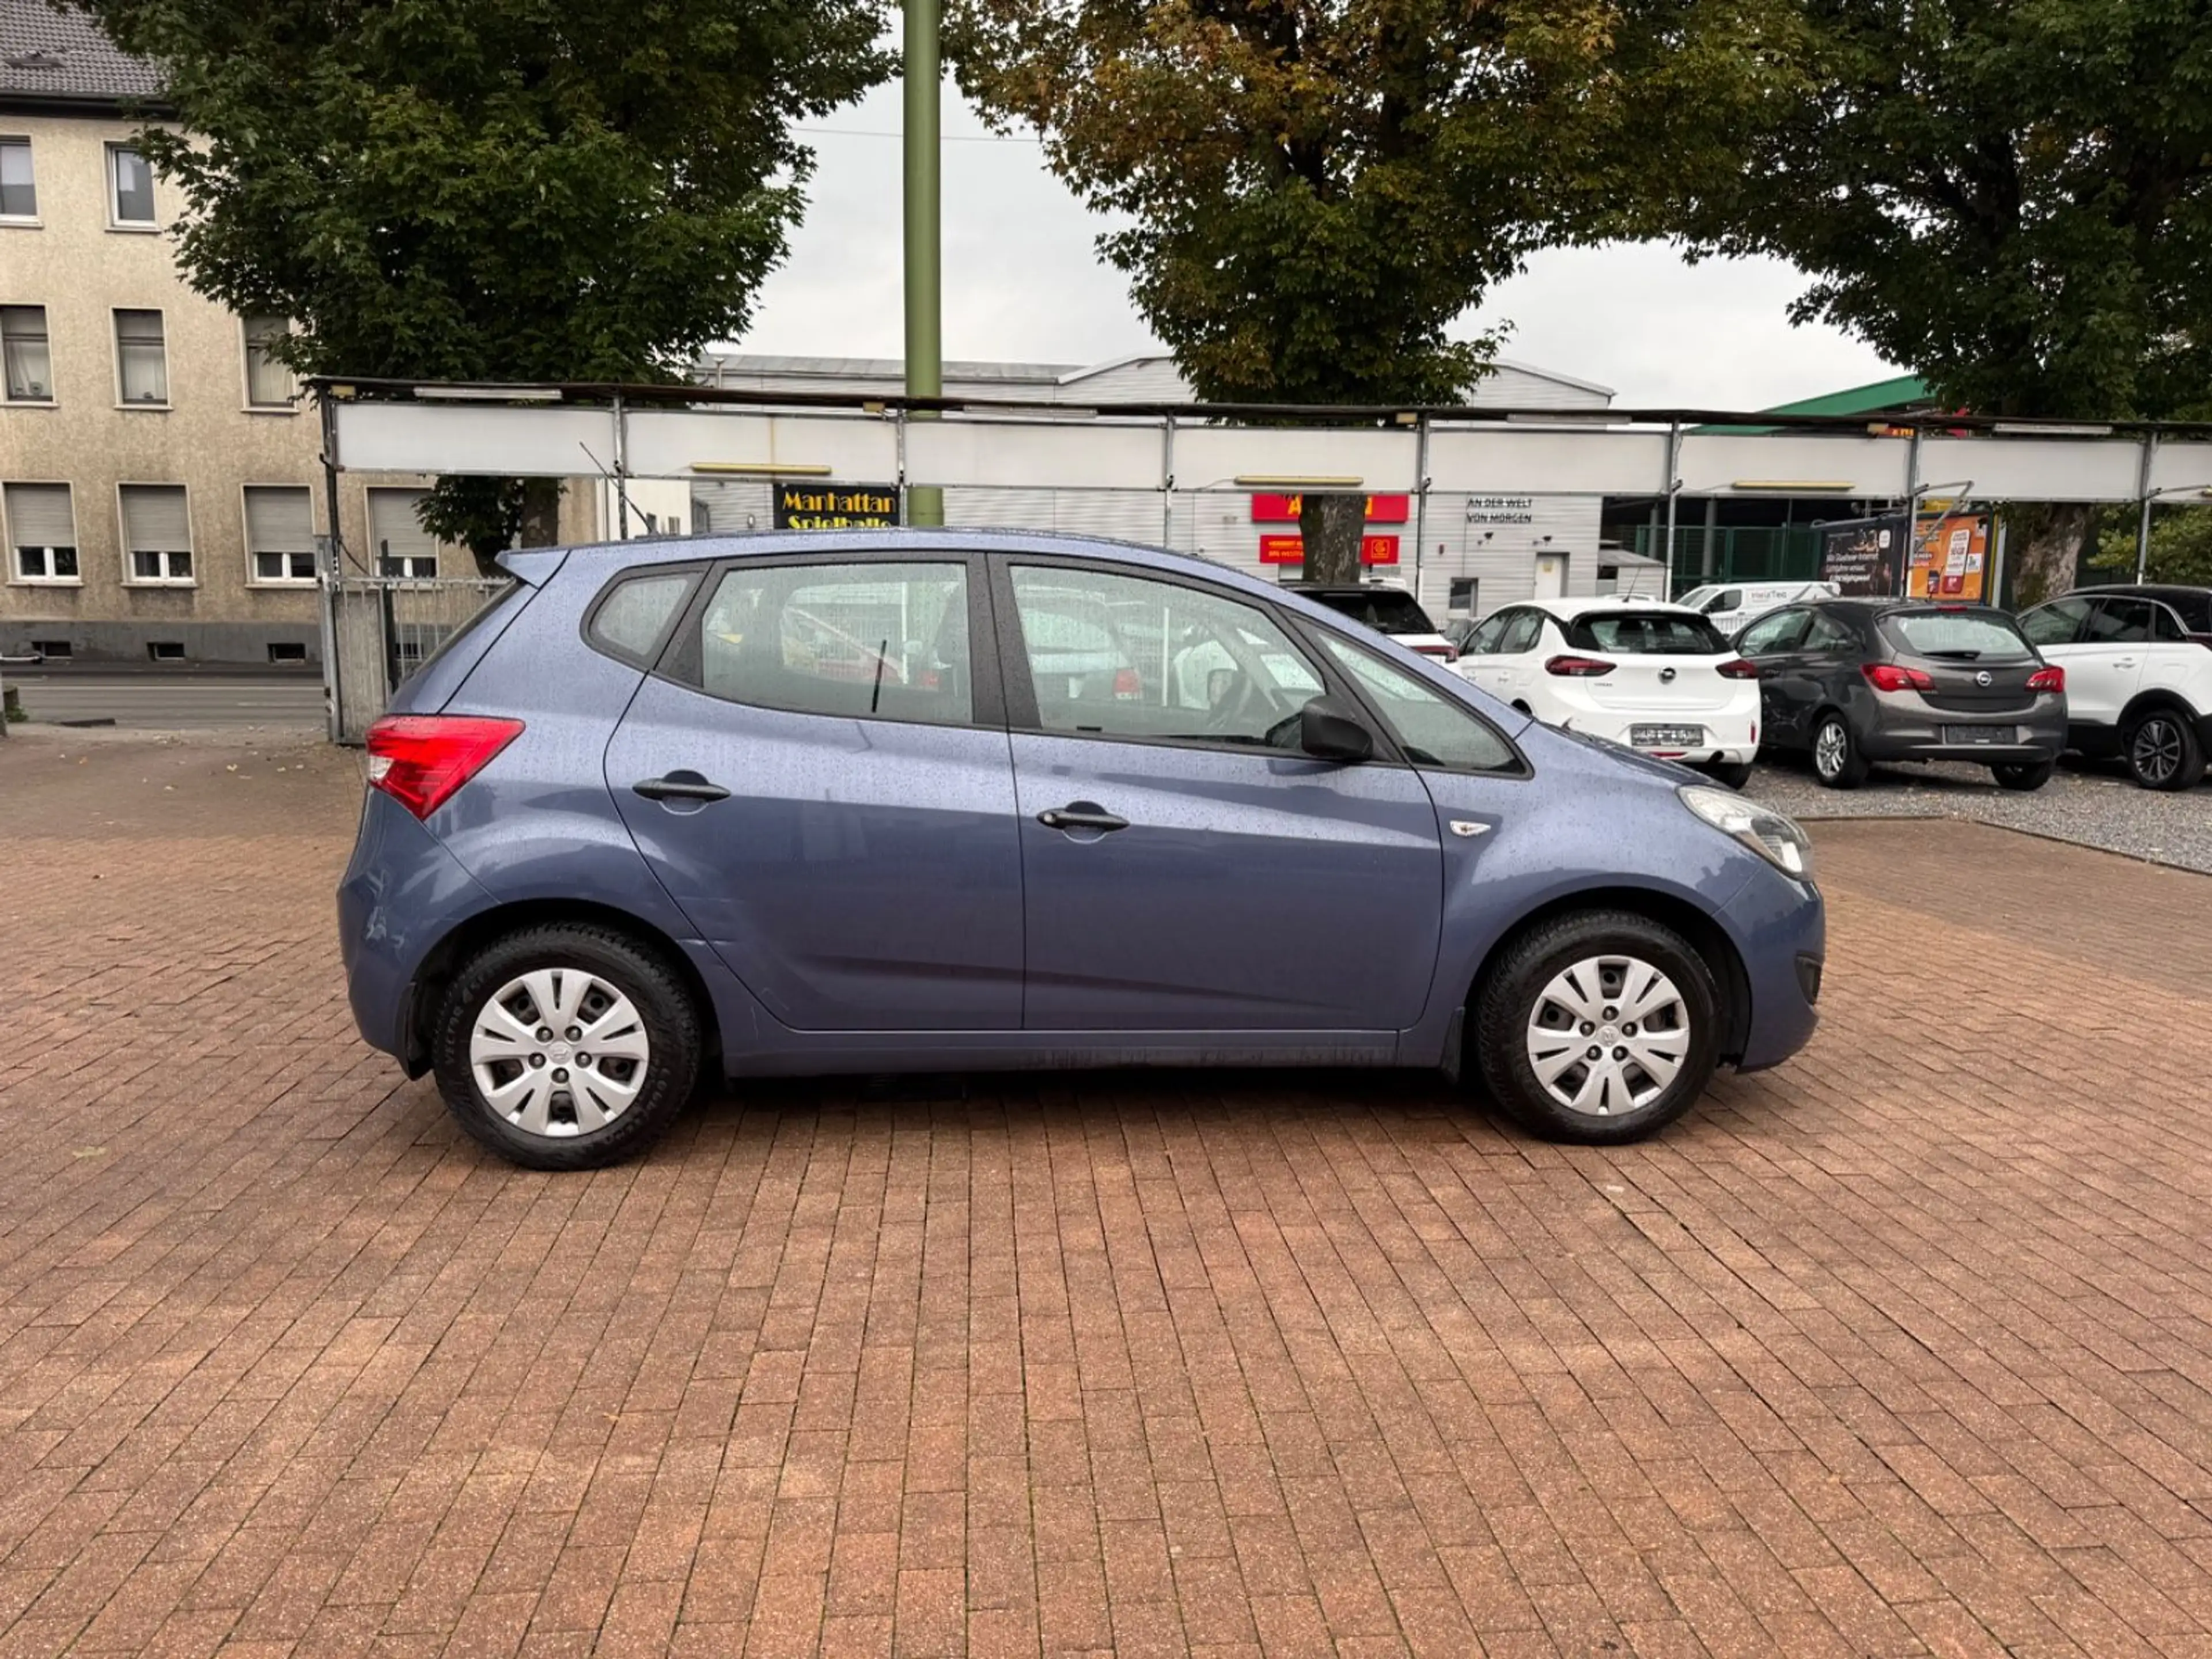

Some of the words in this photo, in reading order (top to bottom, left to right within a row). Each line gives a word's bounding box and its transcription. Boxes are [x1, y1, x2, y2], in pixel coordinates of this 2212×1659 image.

[782, 491, 896, 513] Manhattan
[1467, 498, 1482, 507] AN
[1485, 498, 1504, 507] DER
[1506, 498, 1532, 507] WELT
[1467, 513, 1488, 523] VON
[1490, 513, 1531, 523] MORGEN
